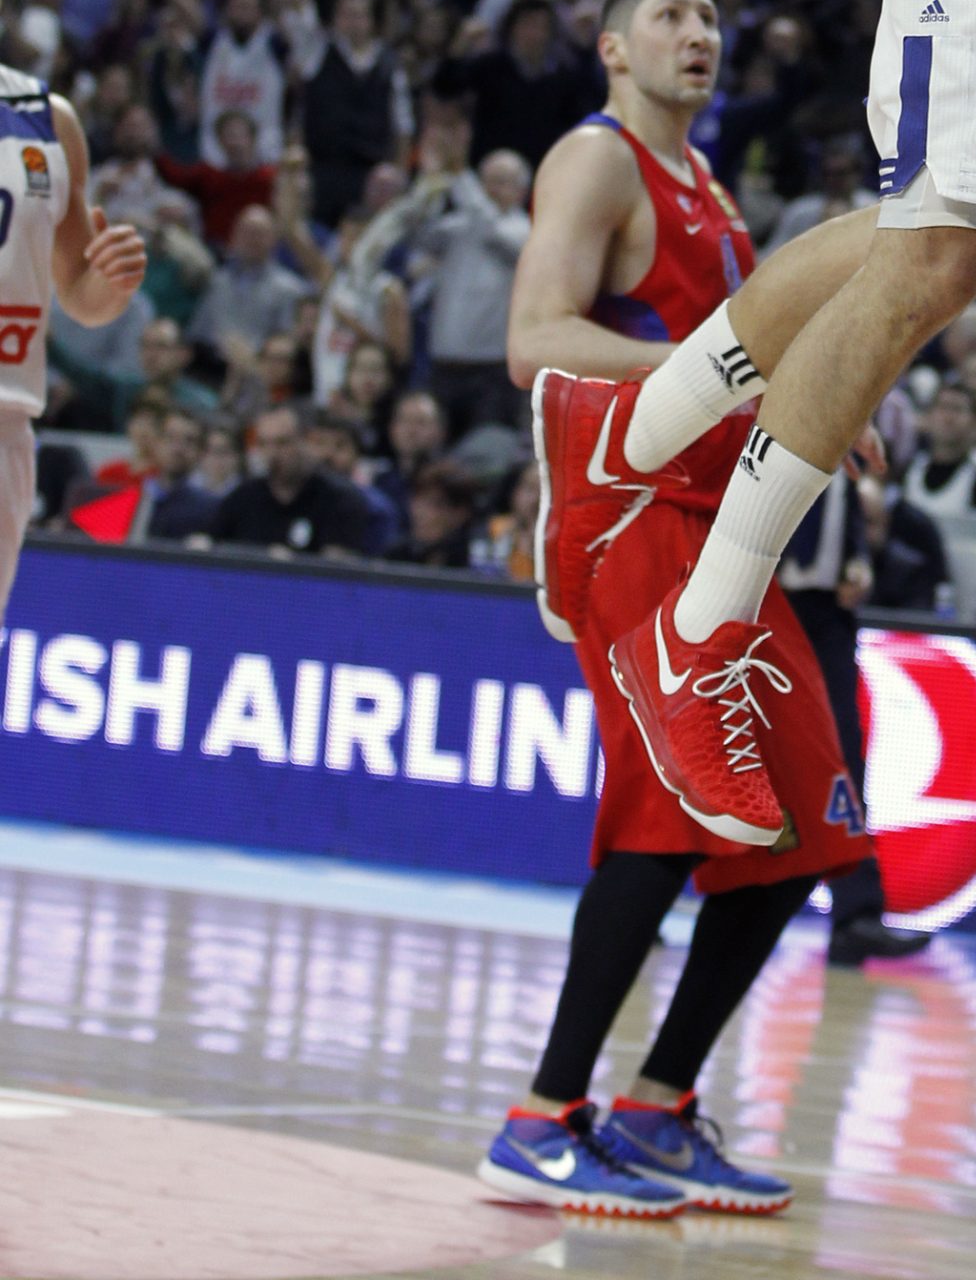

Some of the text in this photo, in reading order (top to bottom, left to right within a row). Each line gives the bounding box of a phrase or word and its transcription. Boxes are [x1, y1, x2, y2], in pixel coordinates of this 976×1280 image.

[0, 628, 606, 799] ISH AIRLIN
[824, 773, 866, 837] 4
